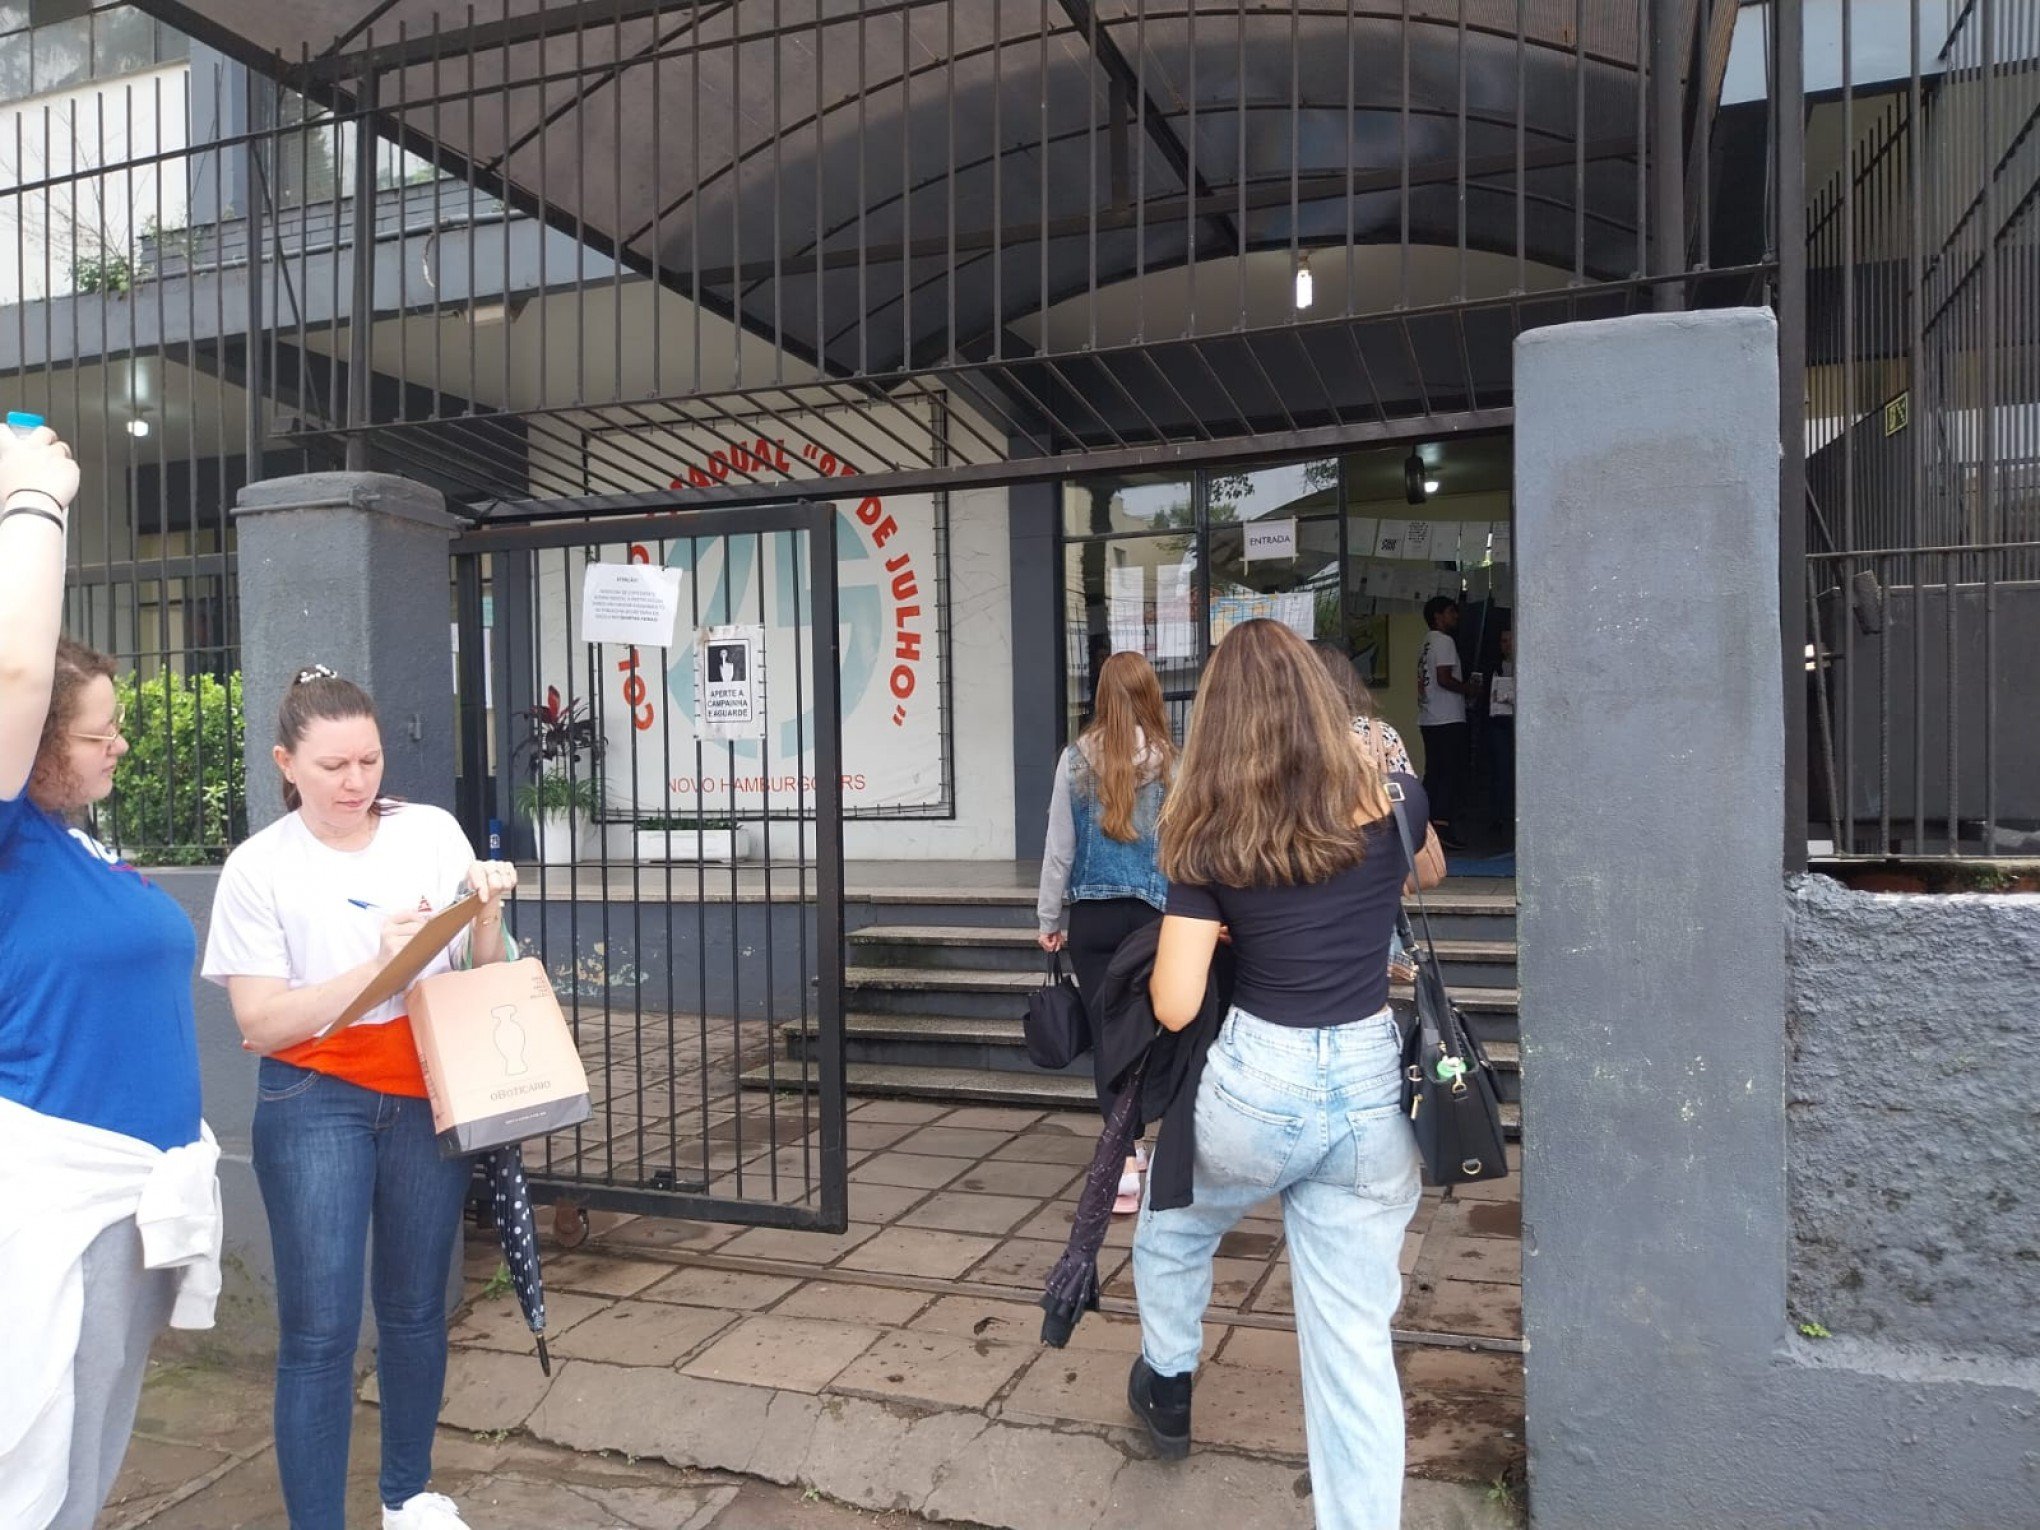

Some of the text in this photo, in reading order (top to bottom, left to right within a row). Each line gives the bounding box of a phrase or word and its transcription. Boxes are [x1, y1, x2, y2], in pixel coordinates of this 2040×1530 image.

[856, 496, 899, 549] DE
[1249, 534, 1291, 547] ENTRADA
[711, 689, 744, 698] APERTE A
[707, 699, 748, 707] CAMPAINHA
[714, 708, 748, 717] AGUARDE
[668, 777, 715, 793] NOVO
